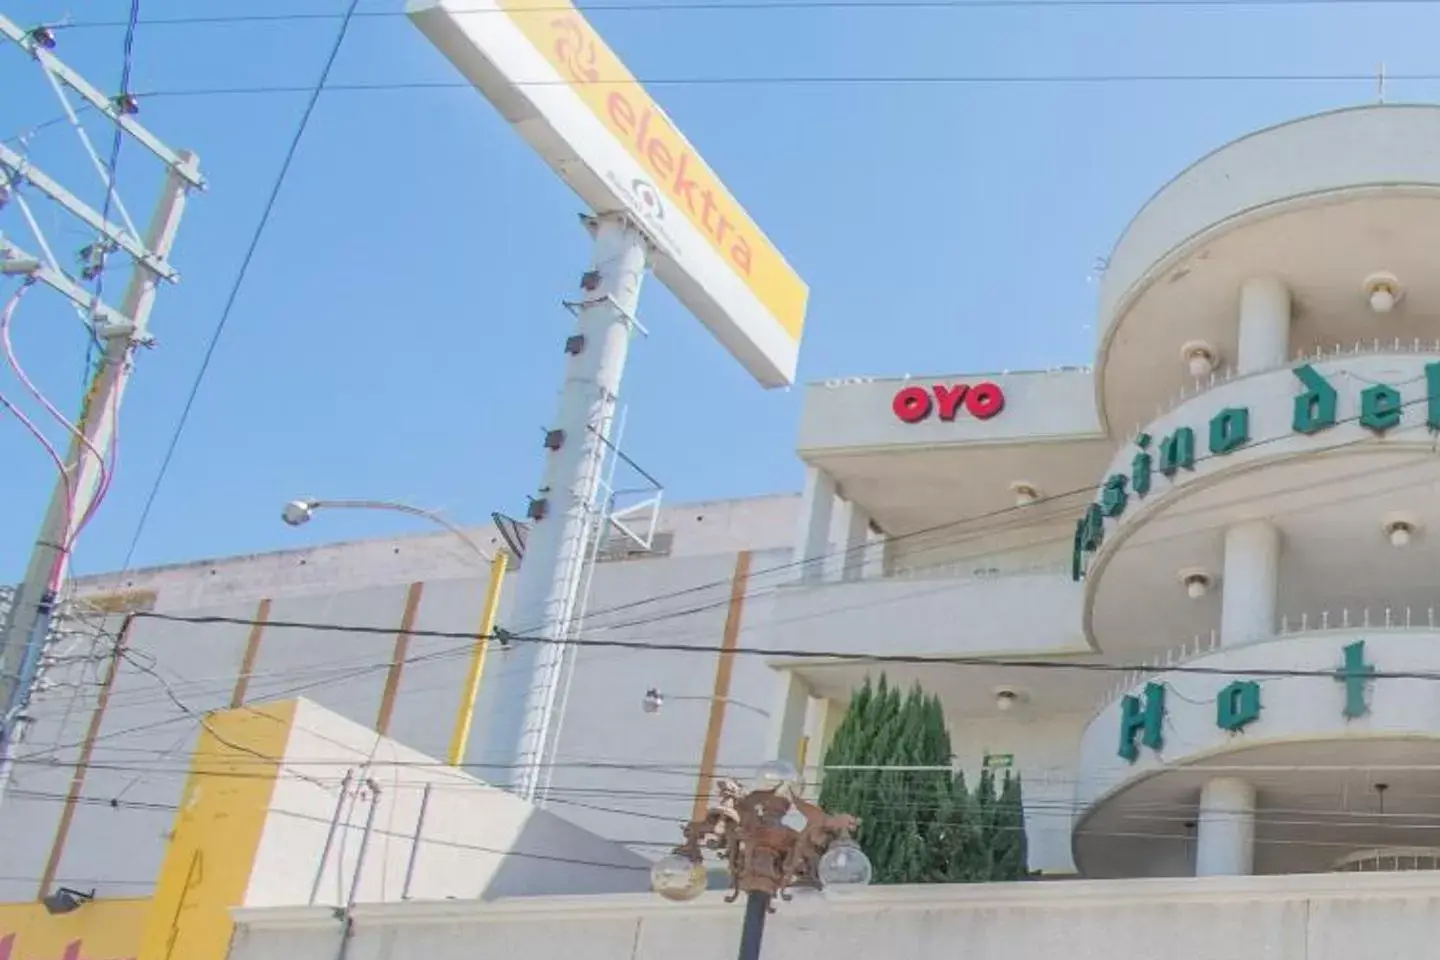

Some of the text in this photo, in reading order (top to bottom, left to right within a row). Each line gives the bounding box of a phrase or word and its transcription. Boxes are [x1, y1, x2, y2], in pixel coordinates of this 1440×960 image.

[606, 91, 752, 277] elektra
[893, 381, 1006, 424] OYO
[1072, 407, 1249, 581] asino
